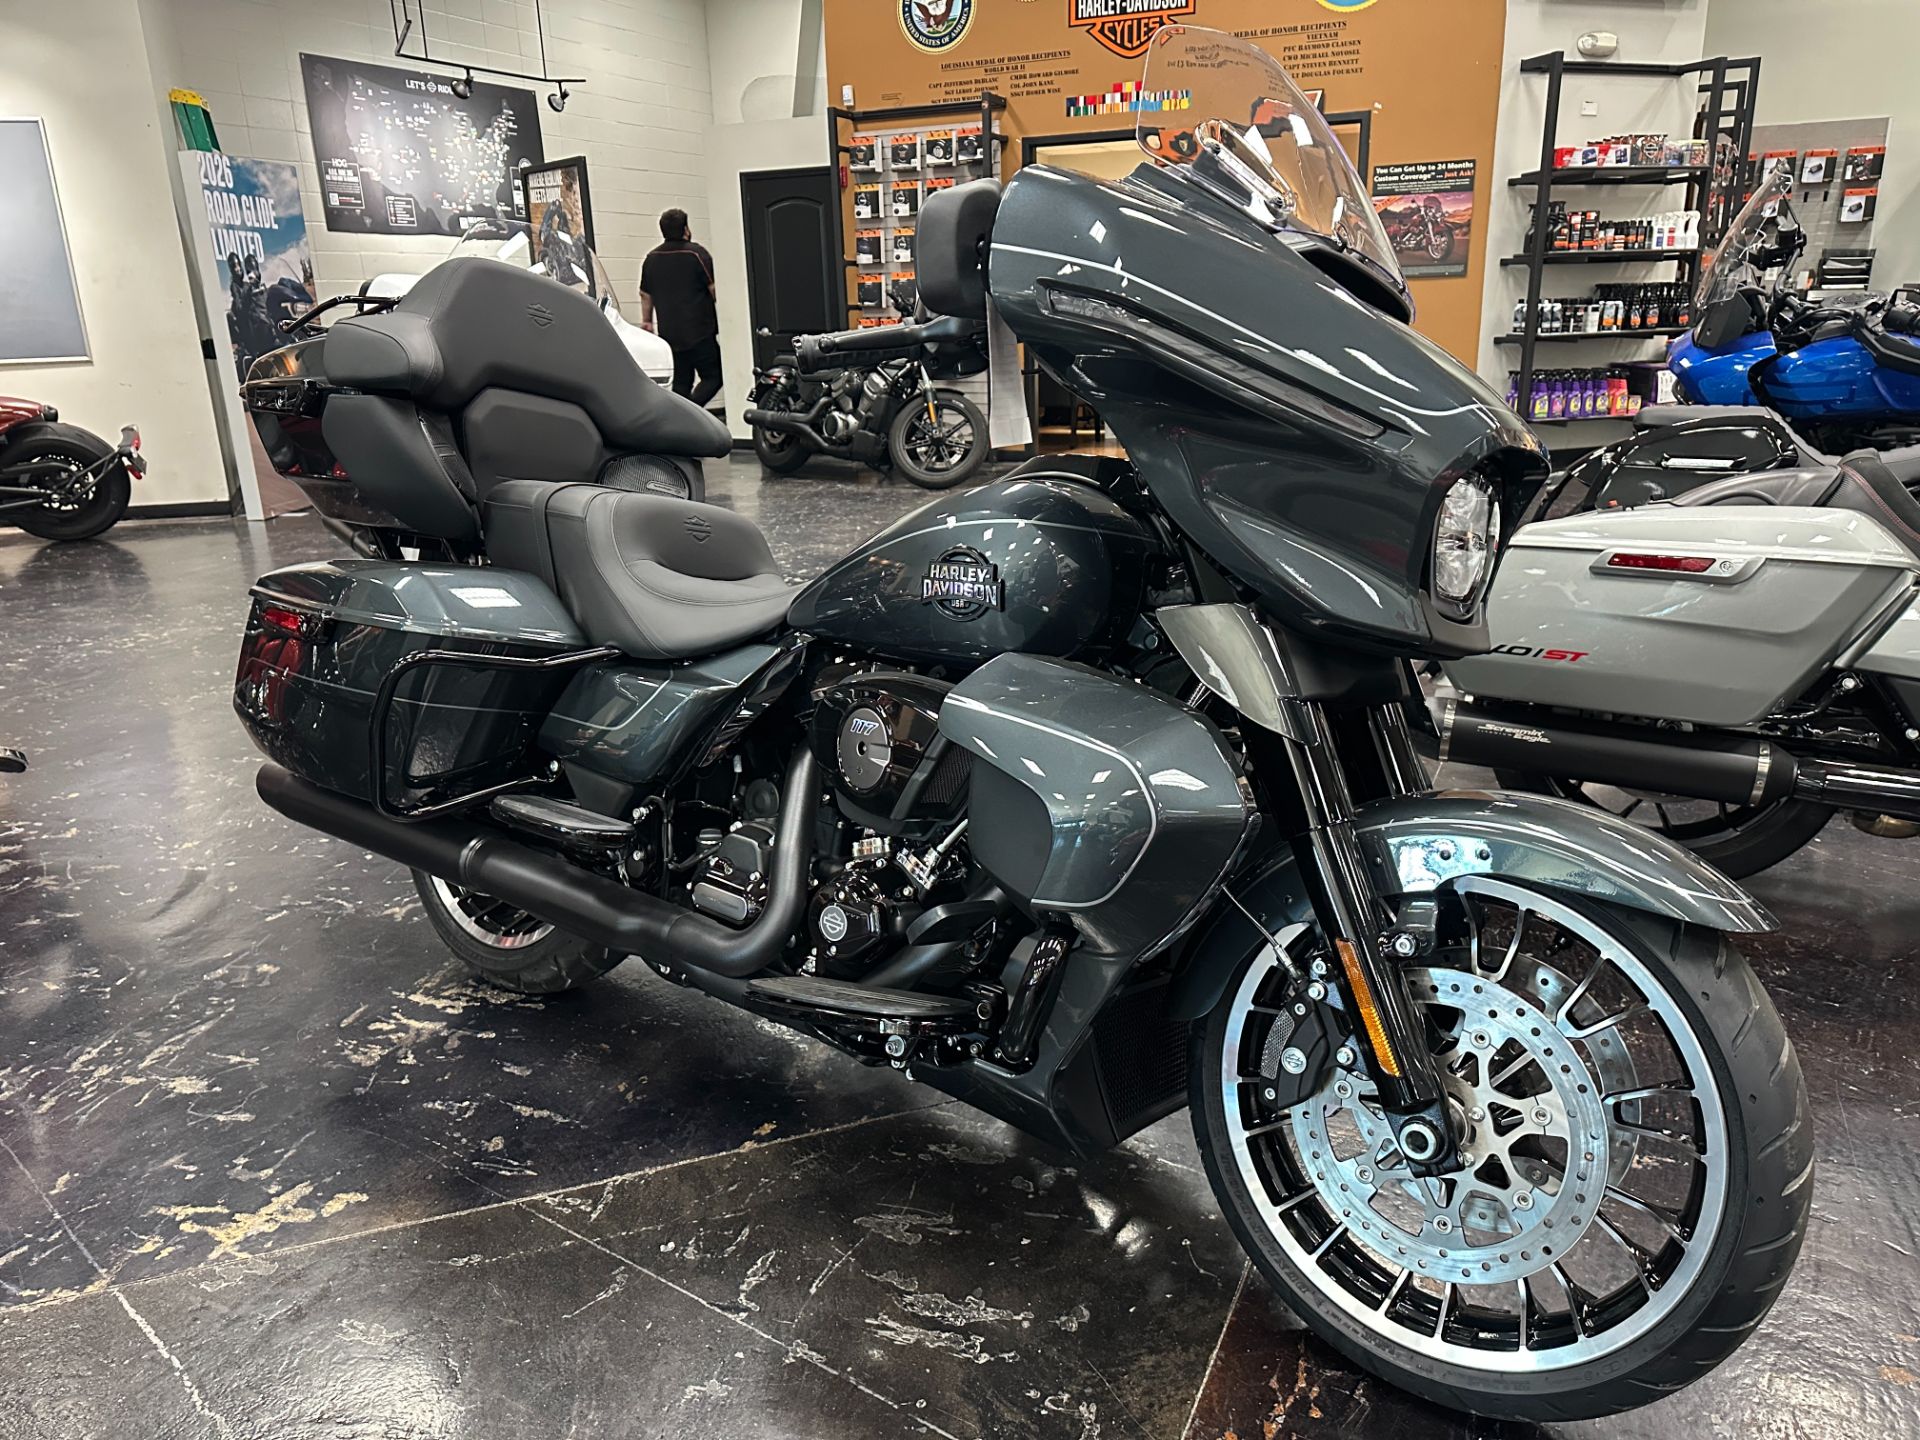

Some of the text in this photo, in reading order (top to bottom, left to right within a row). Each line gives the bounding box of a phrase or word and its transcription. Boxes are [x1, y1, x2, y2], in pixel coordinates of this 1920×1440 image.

[904, 7, 969, 46] UNITED STATES OF AMERICA
[1104, 17, 1160, 48] CYCLES
[1234, 20, 1347, 38] MEDAL OF HONOR RECIPIENTS
[1306, 31, 1339, 41] VIETNAM
[1298, 43, 1331, 51] RAYMOND
[1300, 51, 1329, 60] MICHAEL
[941, 49, 1071, 70] LOUISIANA MEDAL OF HONOR RECIPIENTS
[984, 66, 1005, 74] WORLD
[1301, 69, 1331, 78] DOUGLAS
[405, 79, 426, 91] LET'S
[196, 153, 234, 189] 2026
[1417, 164, 1427, 172] Up
[1447, 161, 1474, 169] Months
[1444, 170, 1457, 178] Just
[203, 189, 279, 230] ROAD GLIDE
[210, 227, 265, 263] LIMITED
[930, 564, 990, 583] HARLEY-
[923, 579, 997, 606] DAVIDSON
[850, 718, 879, 735] 117
[1513, 733, 1551, 743] Eagle
